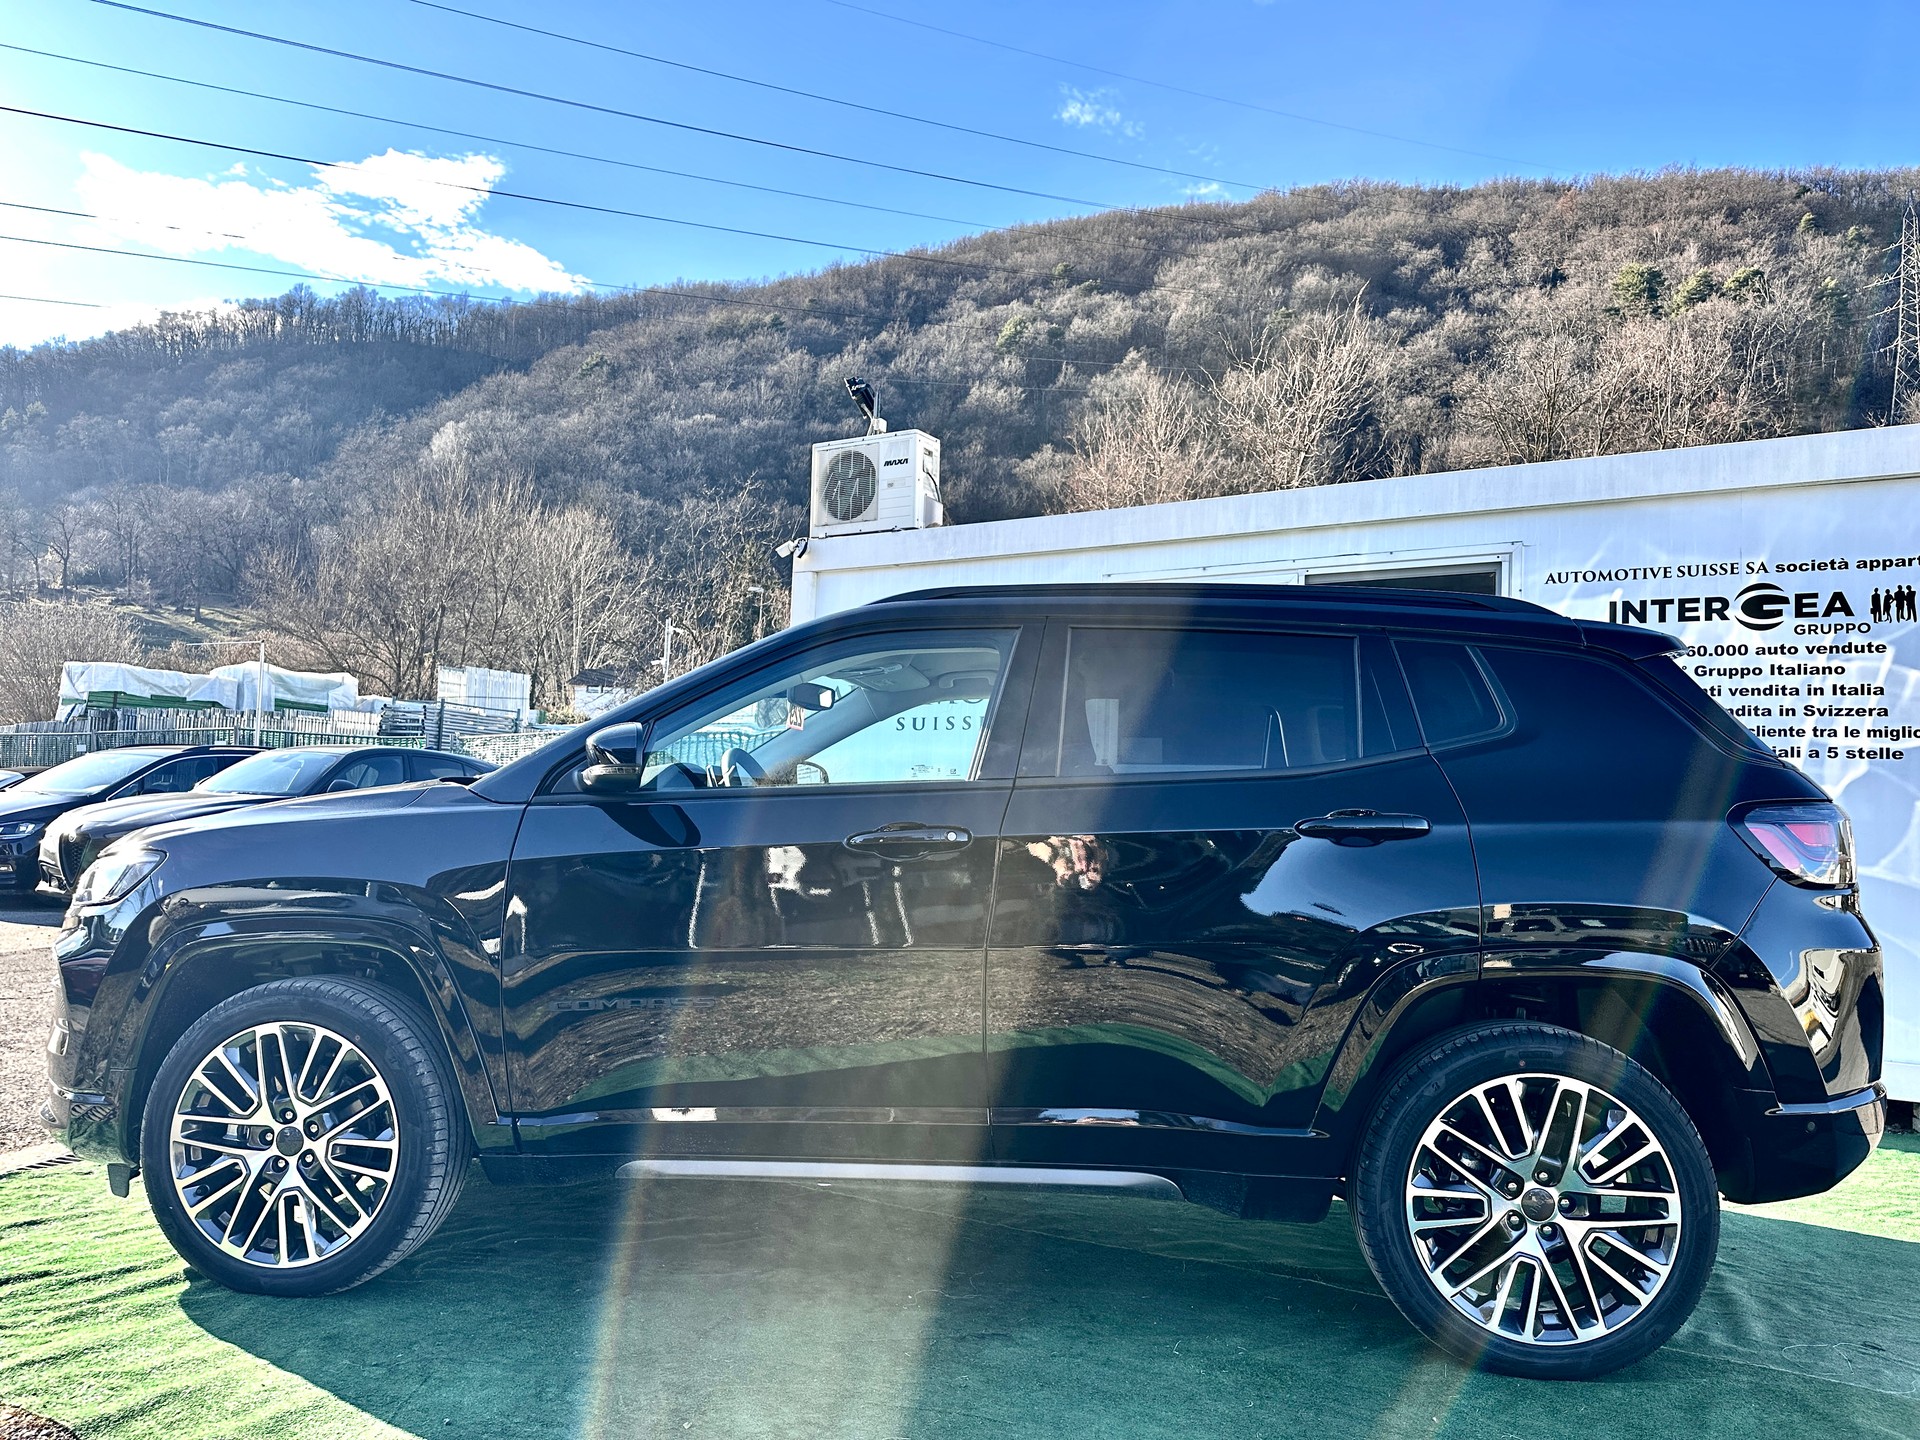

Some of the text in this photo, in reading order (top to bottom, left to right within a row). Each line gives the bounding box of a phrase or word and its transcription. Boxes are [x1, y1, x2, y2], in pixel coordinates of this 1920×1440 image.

[883, 458, 909, 467] MAXA
[1544, 566, 1673, 585] AUTOMOTIVE
[1677, 562, 1740, 578] SUISSE
[1745, 561, 1770, 575] SA
[1775, 557, 1849, 573] società
[1793, 622, 1871, 635] GRUPPO
[1754, 643, 1798, 656] auto
[1805, 642, 1888, 655] vendute
[1694, 665, 1763, 680] Gruppo
[1770, 663, 1846, 676] Italiano
[1728, 684, 1800, 697] vendita
[1807, 684, 1825, 696] in
[1832, 683, 1885, 696] Italia
[1779, 705, 1796, 717] in
[1803, 704, 1889, 717] Svizzera
[896, 715, 985, 731] SUISS
[1812, 725, 1838, 738] tra
[1844, 725, 1860, 738] le
[1808, 749, 1820, 759] a
[1827, 746, 1839, 759] 5
[1845, 747, 1904, 760] stelle
[549, 997, 717, 1012] COMPASS
